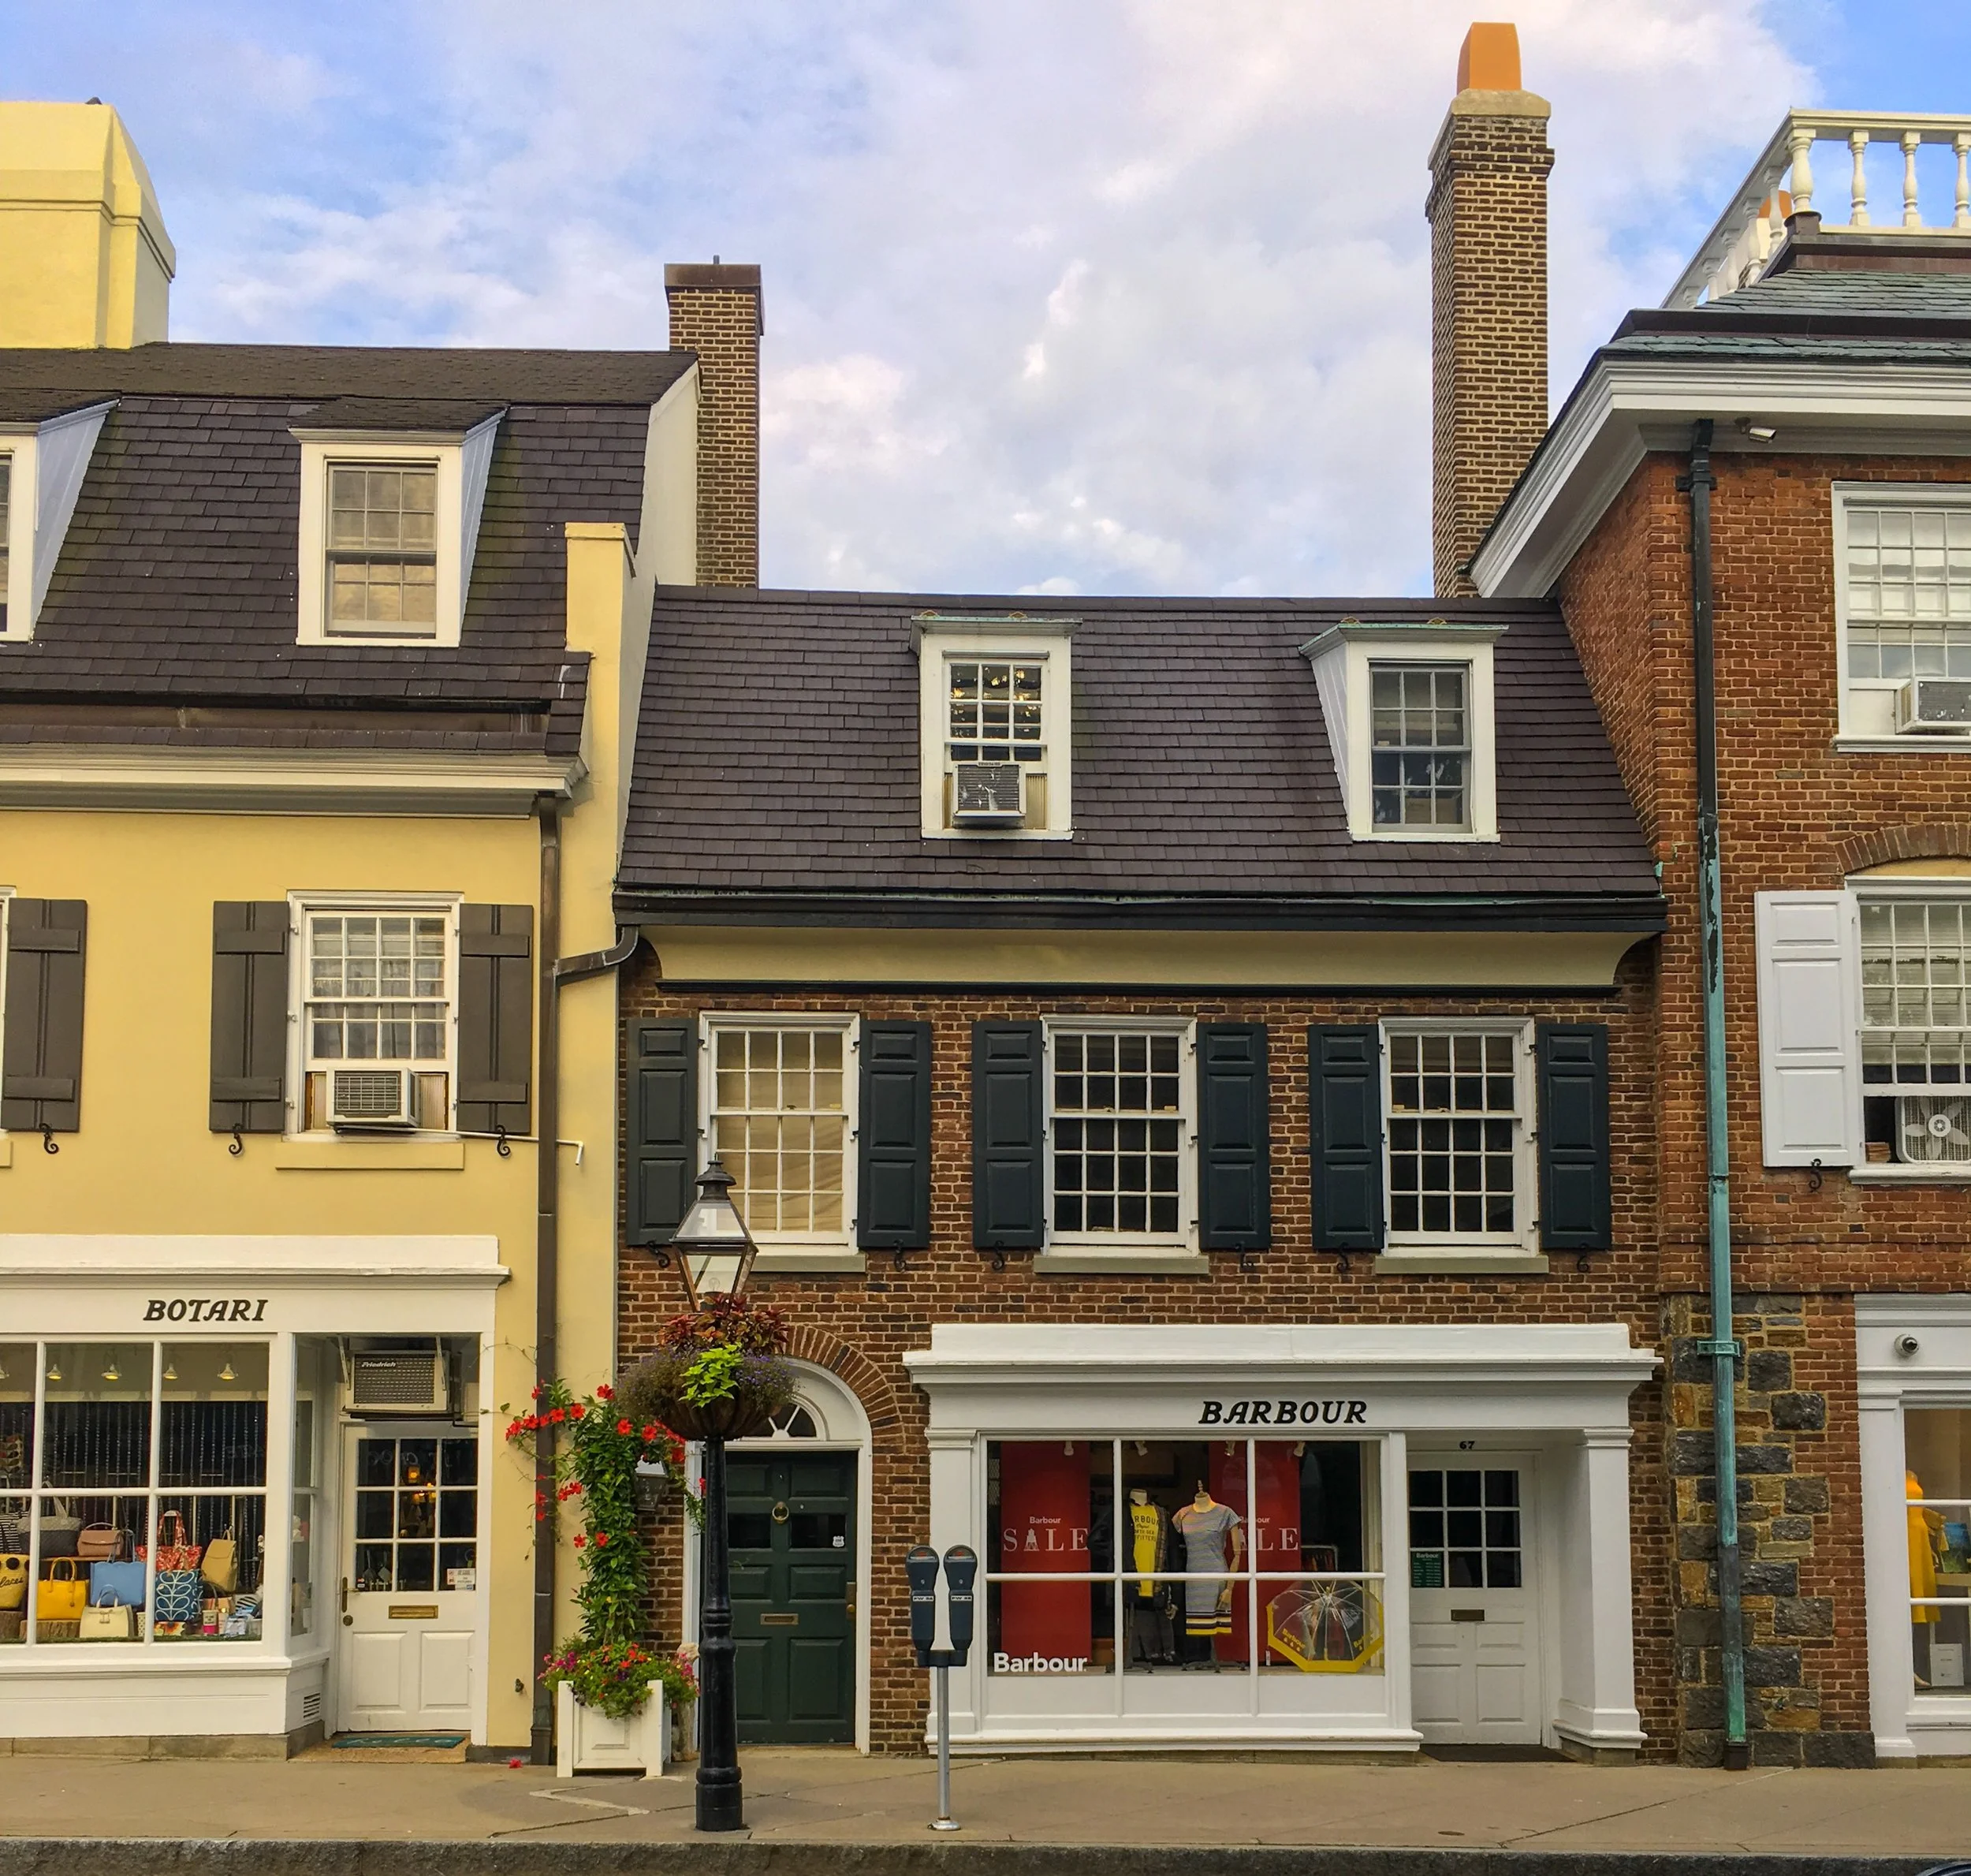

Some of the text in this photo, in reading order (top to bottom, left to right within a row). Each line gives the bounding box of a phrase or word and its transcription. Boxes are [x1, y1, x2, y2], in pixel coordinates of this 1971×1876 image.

[143, 1299, 268, 1322] BOTARI
[1198, 1400, 1366, 1424] BARBOUR
[1459, 1441, 1475, 1450] 67
[1004, 1527, 1088, 1552] SALE
